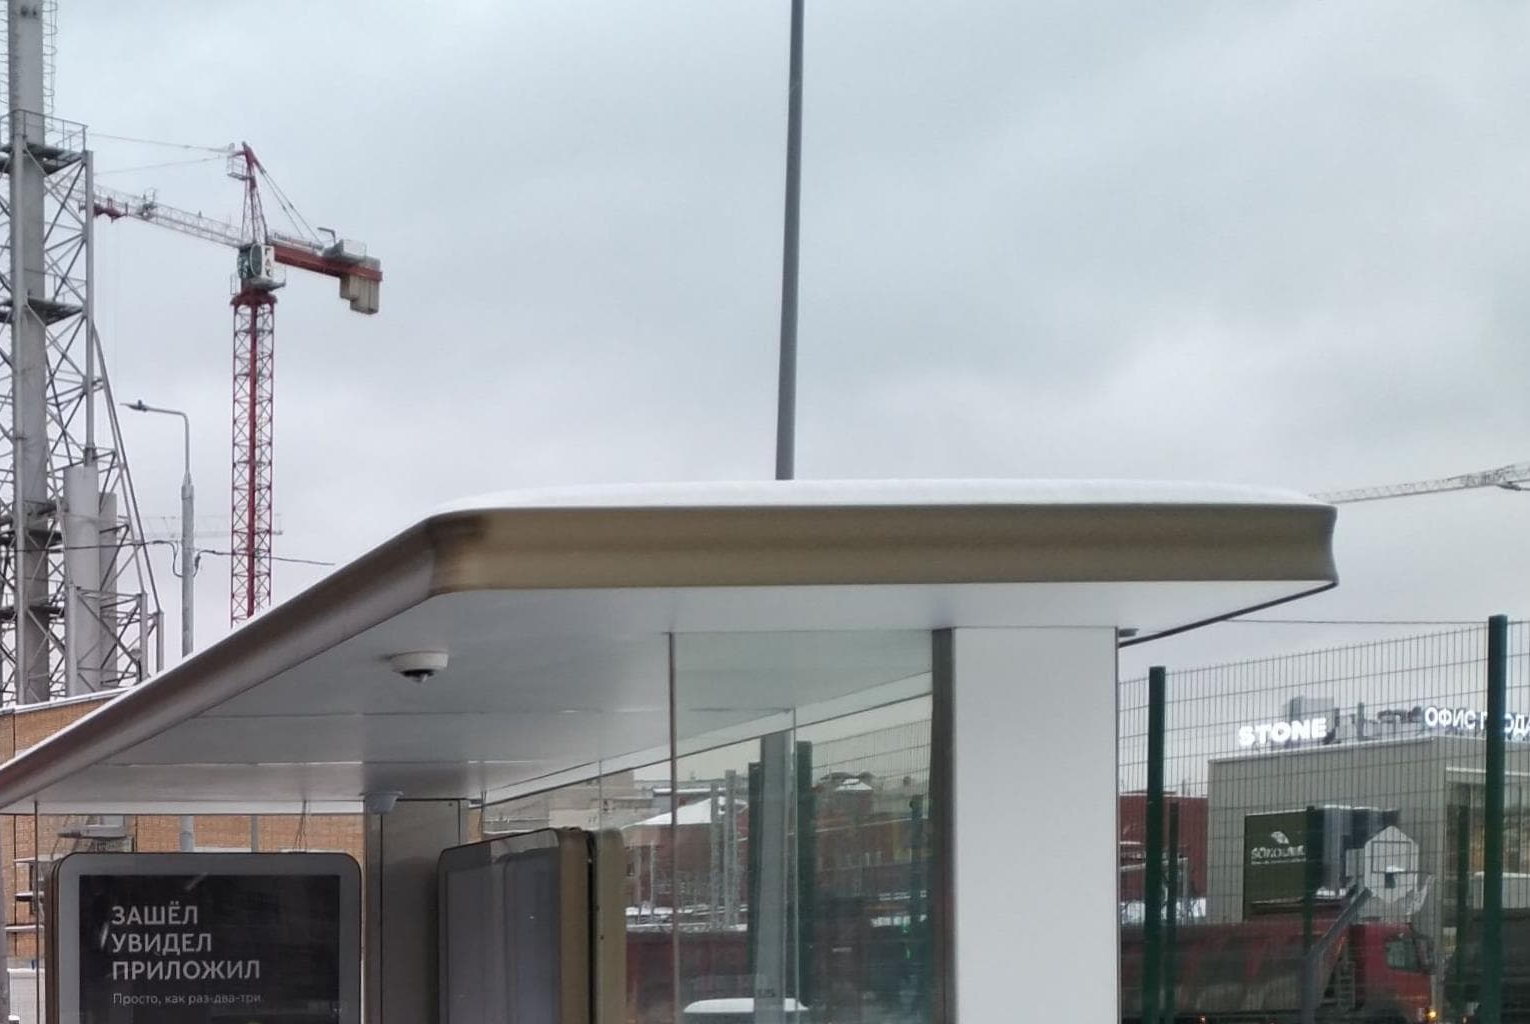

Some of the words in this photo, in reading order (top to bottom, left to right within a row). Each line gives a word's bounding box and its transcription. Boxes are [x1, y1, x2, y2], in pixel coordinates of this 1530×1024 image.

[1239, 717, 1327, 746] STONE
[111, 900, 198, 926] ЗАШЁЛ
[111, 932, 212, 956] УВИДЕЛ
[112, 960, 260, 981] ПРИЛОЖИЛ
[113, 992, 162, 1006] Просто,
[165, 994, 186, 1004] как
